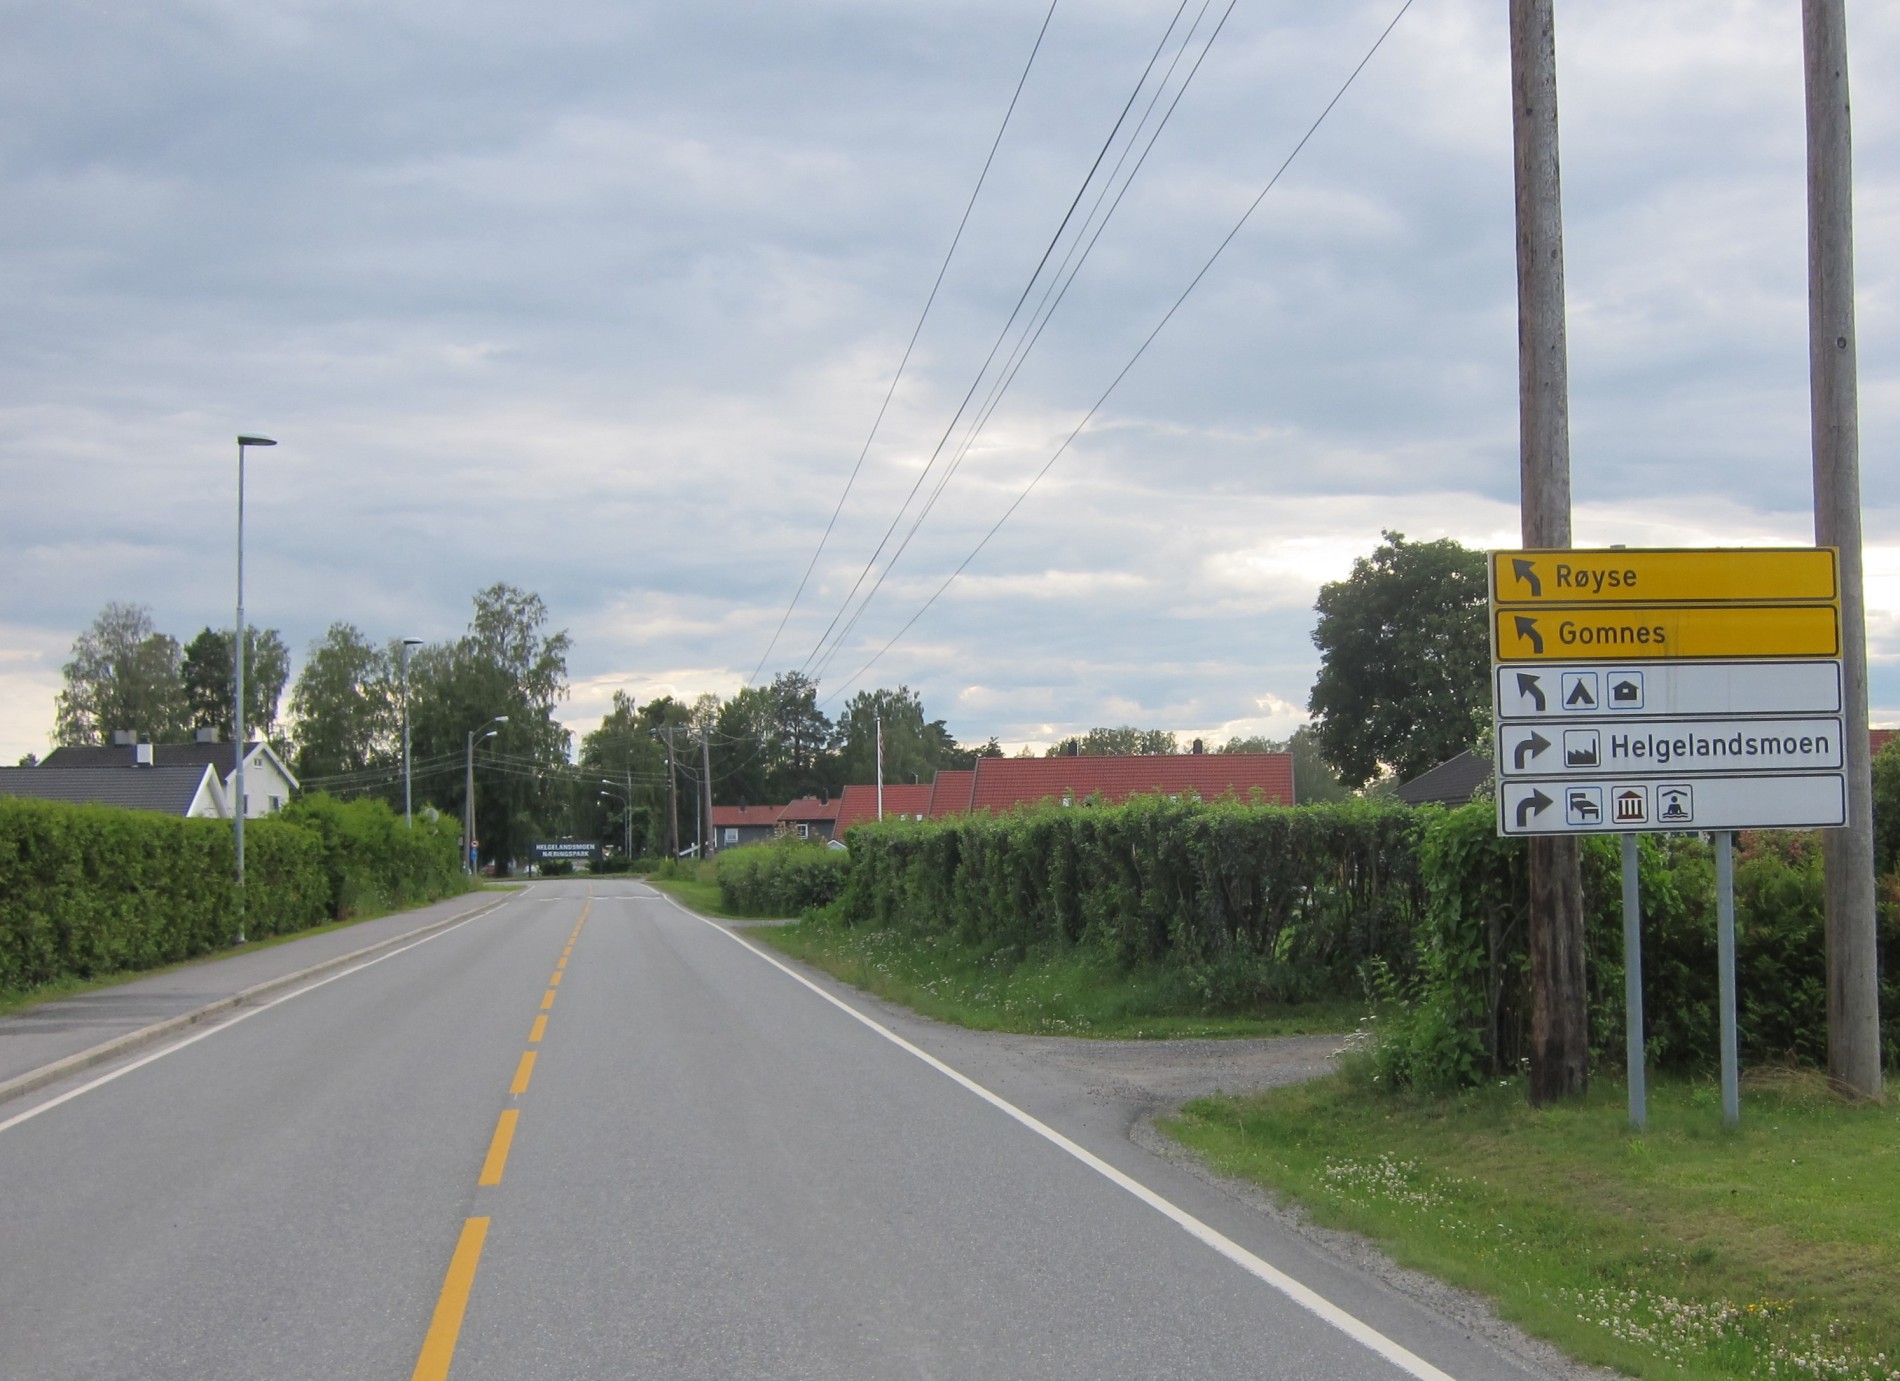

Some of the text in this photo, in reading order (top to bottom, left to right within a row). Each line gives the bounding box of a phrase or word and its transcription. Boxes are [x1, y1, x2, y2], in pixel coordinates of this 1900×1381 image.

[1556, 564, 1637, 594] Røyse
[1559, 621, 1666, 645] Gomnes
[1611, 733, 1829, 763] Helgelandsmoen
